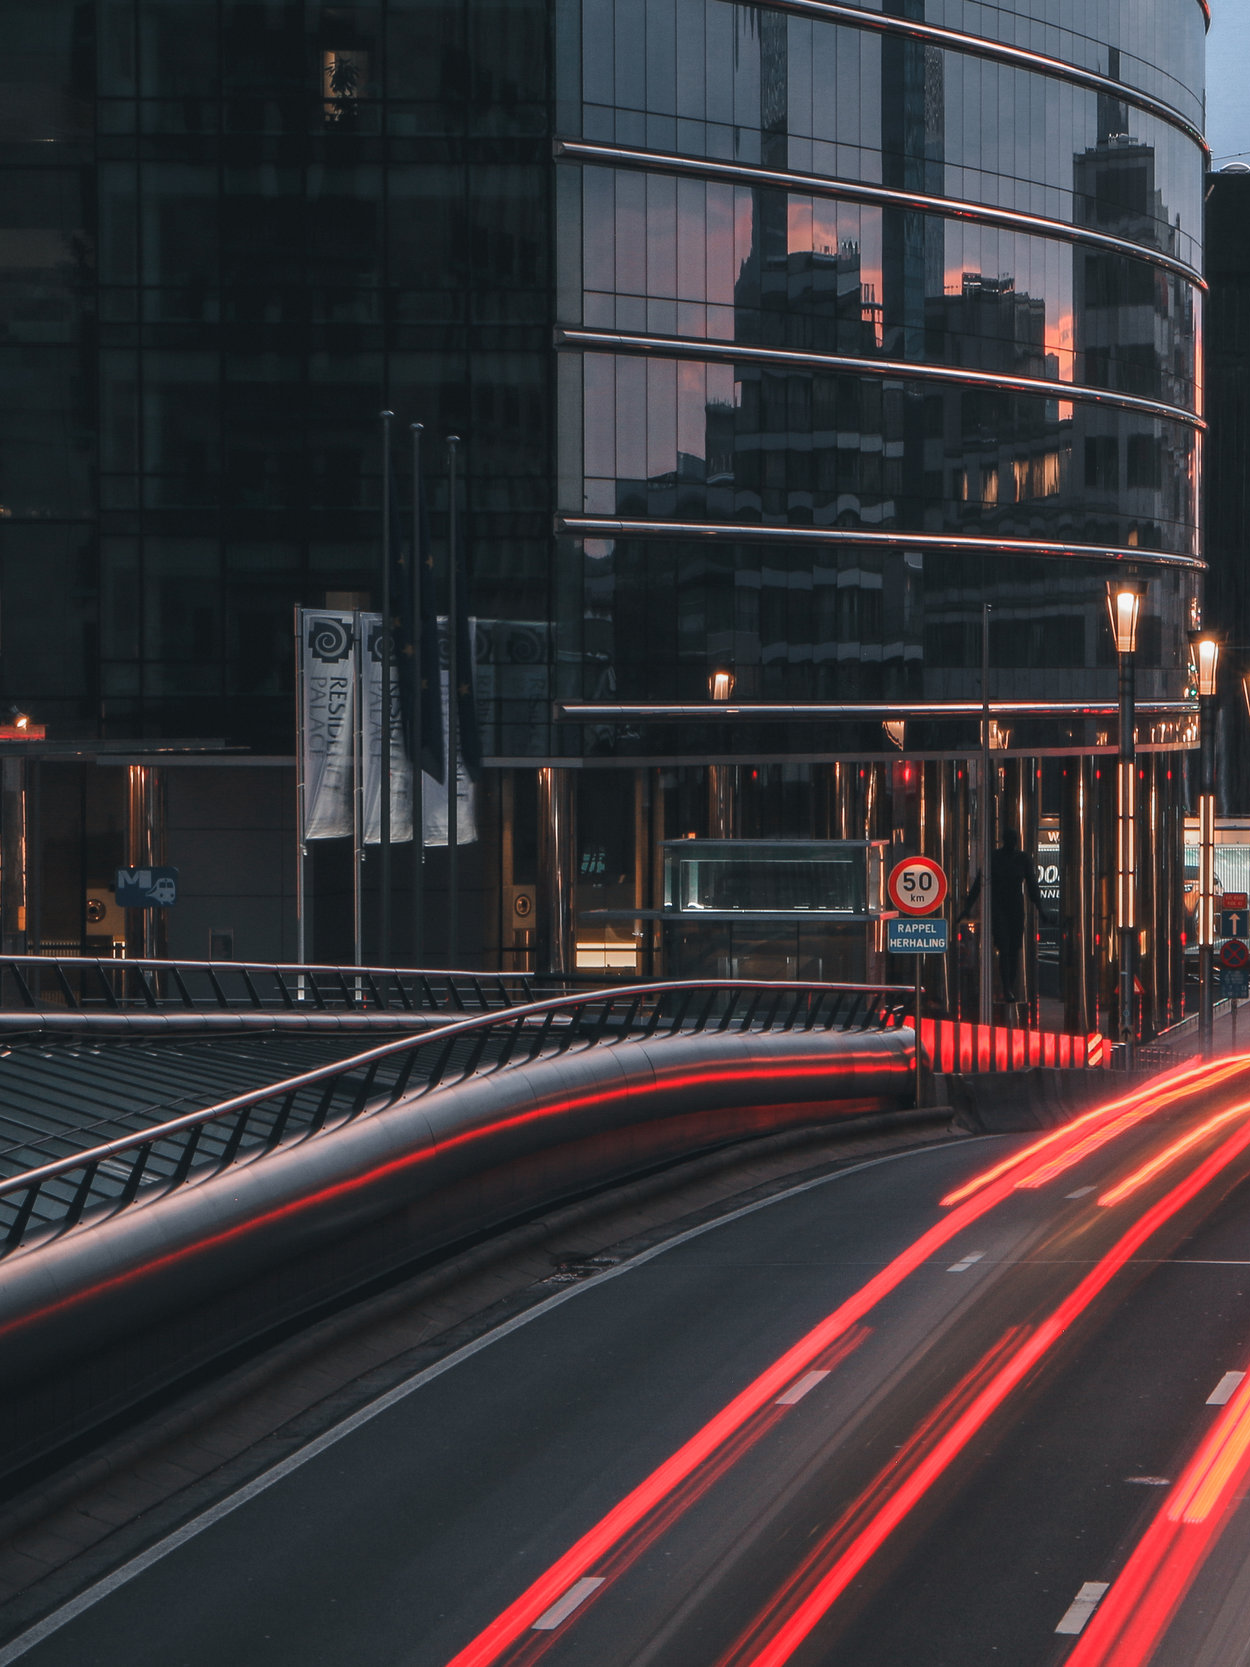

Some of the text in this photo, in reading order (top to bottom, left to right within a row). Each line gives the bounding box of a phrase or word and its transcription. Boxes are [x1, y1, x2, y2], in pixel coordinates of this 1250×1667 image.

[903, 872, 932, 891] 50
[910, 894, 925, 902] km
[898, 924, 937, 933] RAPPEL
[890, 938, 945, 948] HERHALING
